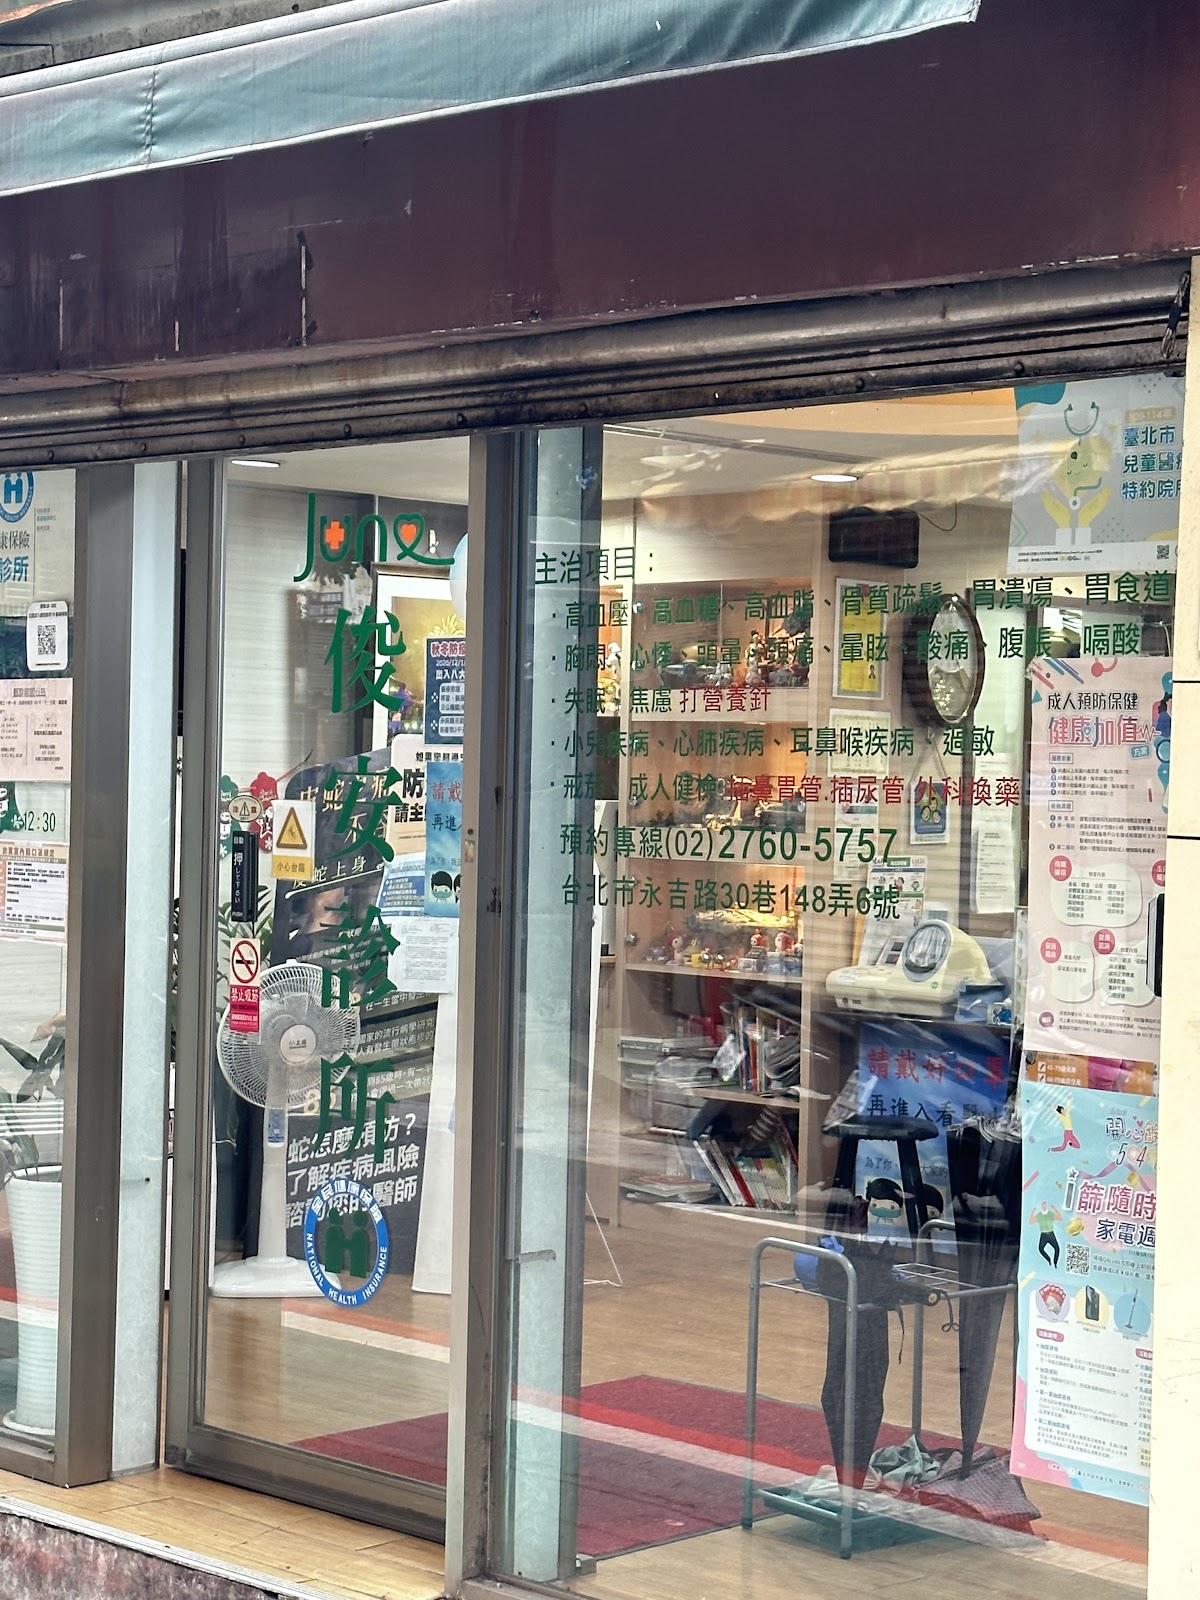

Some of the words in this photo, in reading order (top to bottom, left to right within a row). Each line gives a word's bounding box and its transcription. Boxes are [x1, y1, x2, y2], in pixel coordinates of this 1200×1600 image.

[1124, 426, 1175, 448] 臺北市
[679, 684, 771, 714] 打營養針
[1047, 692, 1139, 711] 成人預防保健
[1048, 714, 1141, 747] 健康加值
[403, 768, 427, 797] 防
[24, 811, 56, 832] 12:30
[395, 802, 427, 823] 請主
[432, 813, 463, 832] 再進
[561, 875, 901, 920] 台北市永吉路30巷148弄6號
[311, 1180, 383, 1223] 全民健康保險
[306, 1232, 325, 1288] NATIONAL
[328, 1289, 358, 1305] HEALTH
[362, 1246, 388, 1300] INSURANCE
